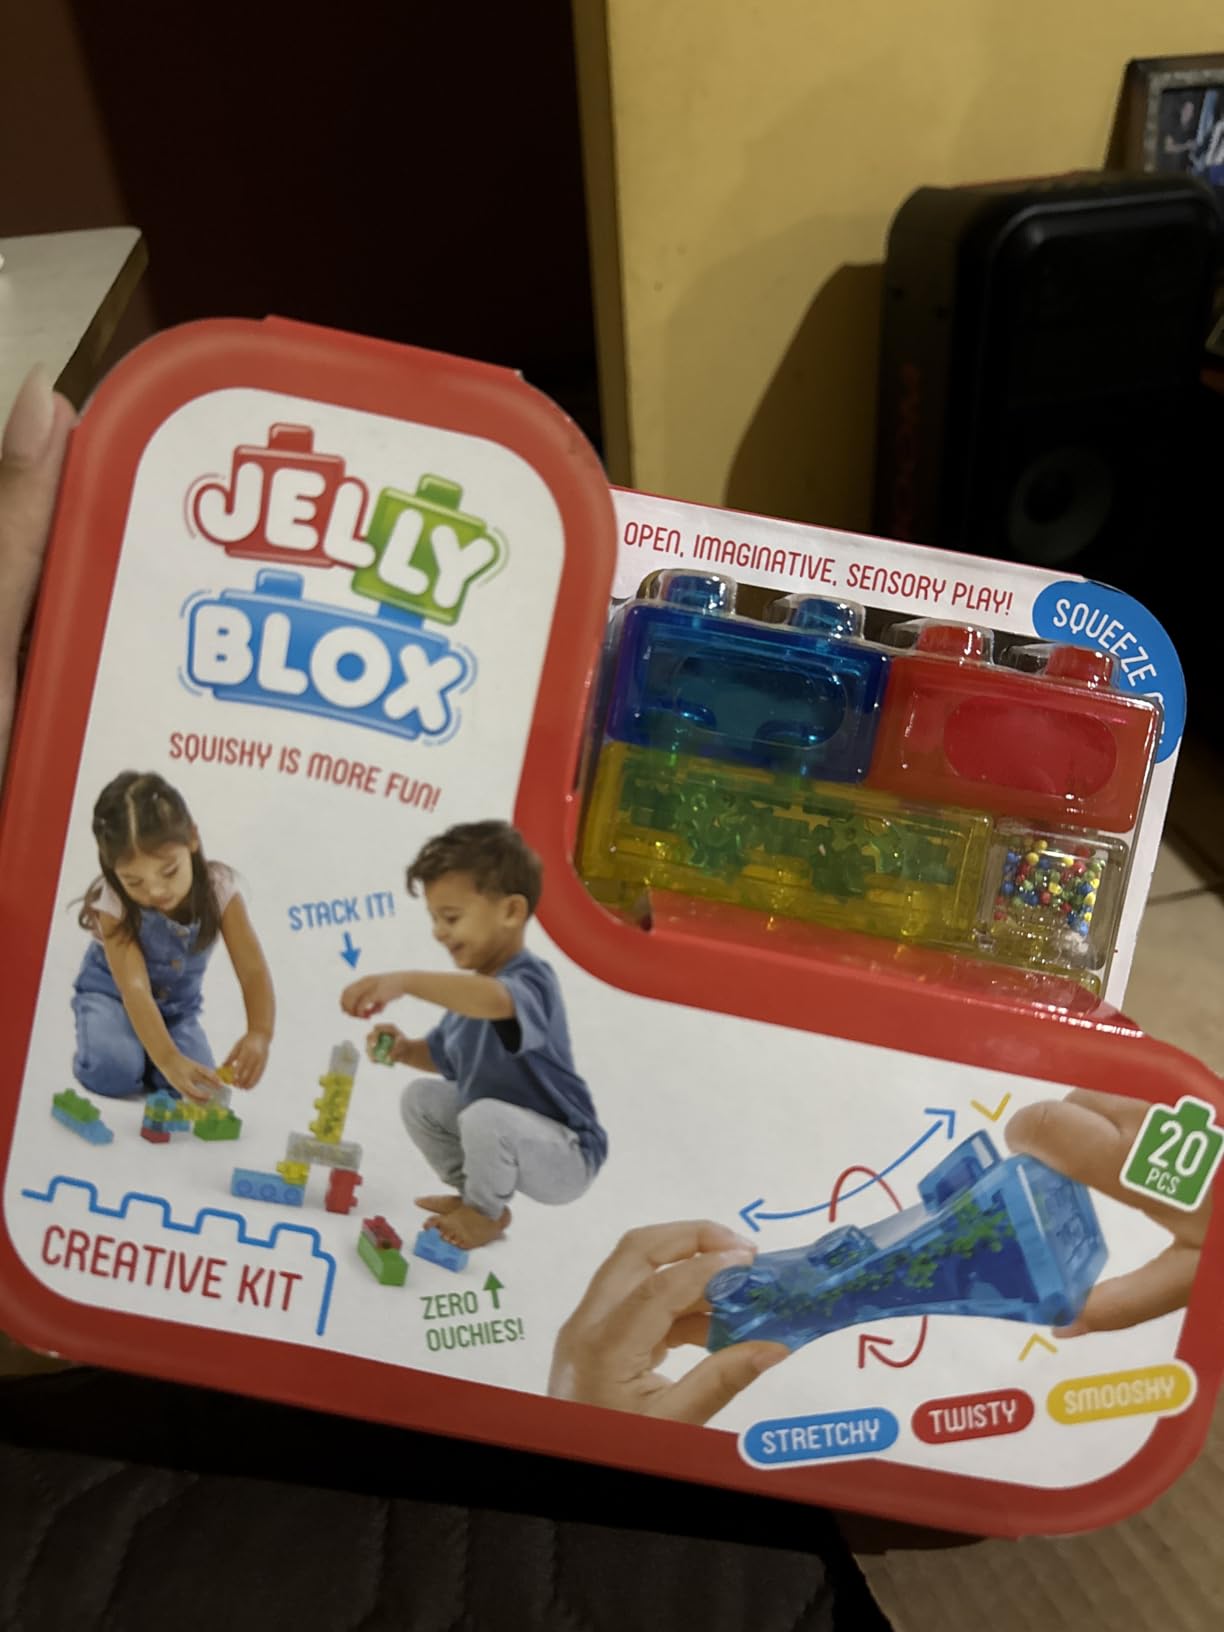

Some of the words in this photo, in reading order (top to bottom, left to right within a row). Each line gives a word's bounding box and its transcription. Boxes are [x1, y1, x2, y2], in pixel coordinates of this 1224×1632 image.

[194, 462, 495, 608] JELLY
[624, 522, 684, 558] OPEN,
[693, 534, 837, 587] IMAGINATIVE,
[846, 563, 947, 608] SENSORY
[952, 583, 1013, 616] PLAY!
[1053, 599, 1157, 687] SQUEEZE
[193, 605, 464, 732] BLOX
[169, 732, 272, 769] SQUISHY
[278, 747, 301, 774] IS
[307, 752, 382, 793] MORE
[385, 773, 441, 813] FUN!
[288, 896, 358, 931] STACK
[366, 892, 396, 917] IT!
[1148, 1120, 1208, 1176] 20
[1145, 1168, 1180, 1194] PCS
[41, 1225, 228, 1299] CREATIVE
[237, 1264, 303, 1312] KIT
[420, 1291, 479, 1320] ZERO
[425, 1317, 524, 1352] OUCHIES!
[928, 1399, 1018, 1434] TWISTY
[1063, 1375, 1176, 1414] SMOOSHY
[761, 1418, 880, 1455] STRETCHY
